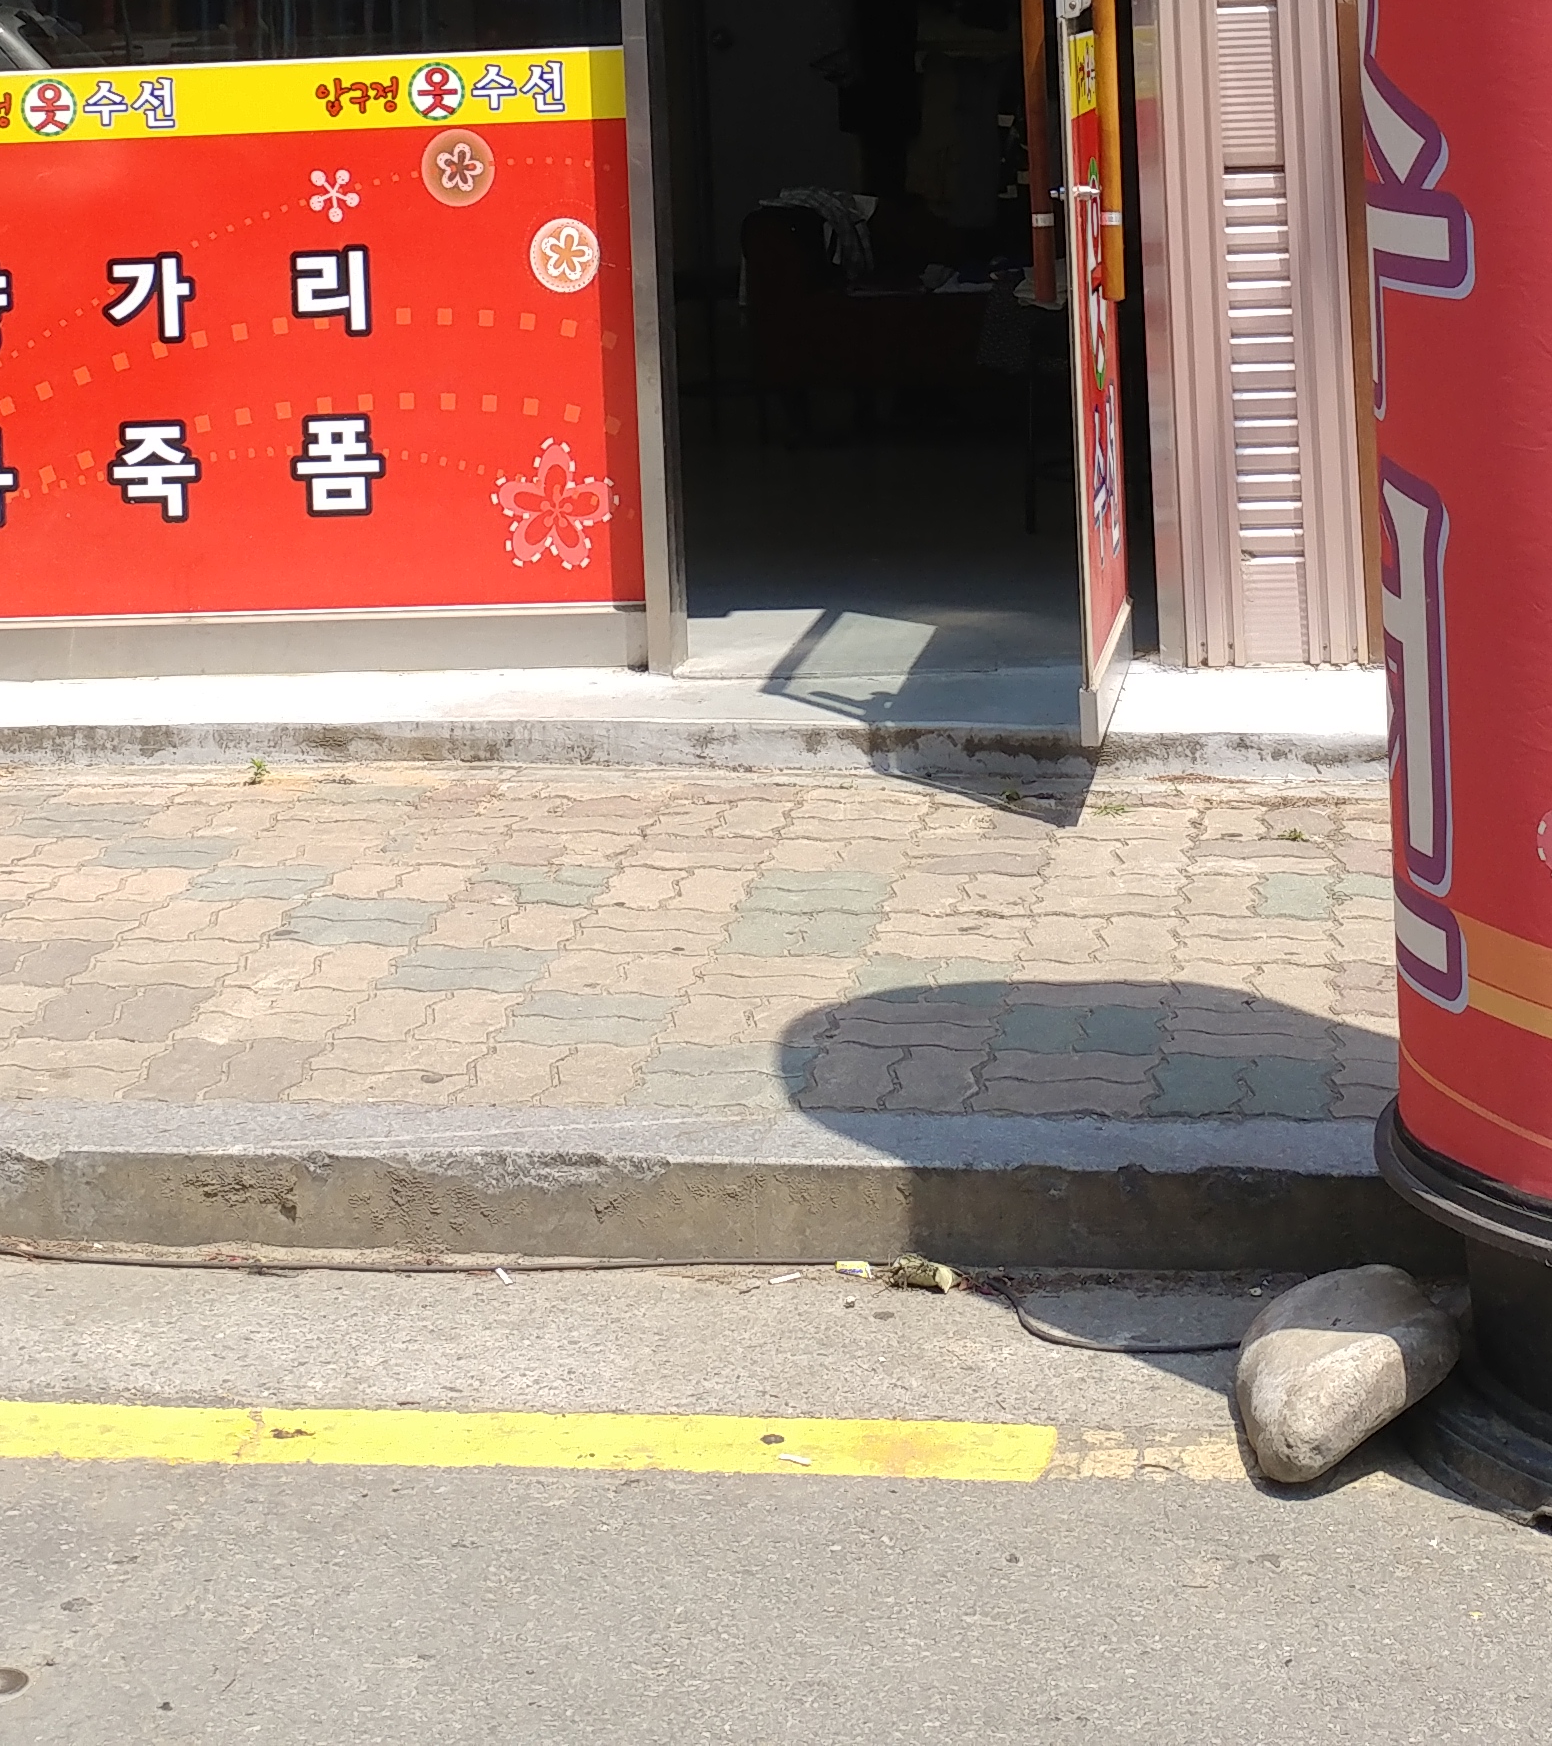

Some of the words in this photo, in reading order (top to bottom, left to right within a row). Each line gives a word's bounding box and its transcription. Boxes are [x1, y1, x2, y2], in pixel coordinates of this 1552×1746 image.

[30, 83, 71, 132] 옷
[83, 77, 176, 129] 수선
[315, 76, 398, 117] 압구정
[417, 67, 458, 116] 옷
[471, 60, 566, 113] 수선
